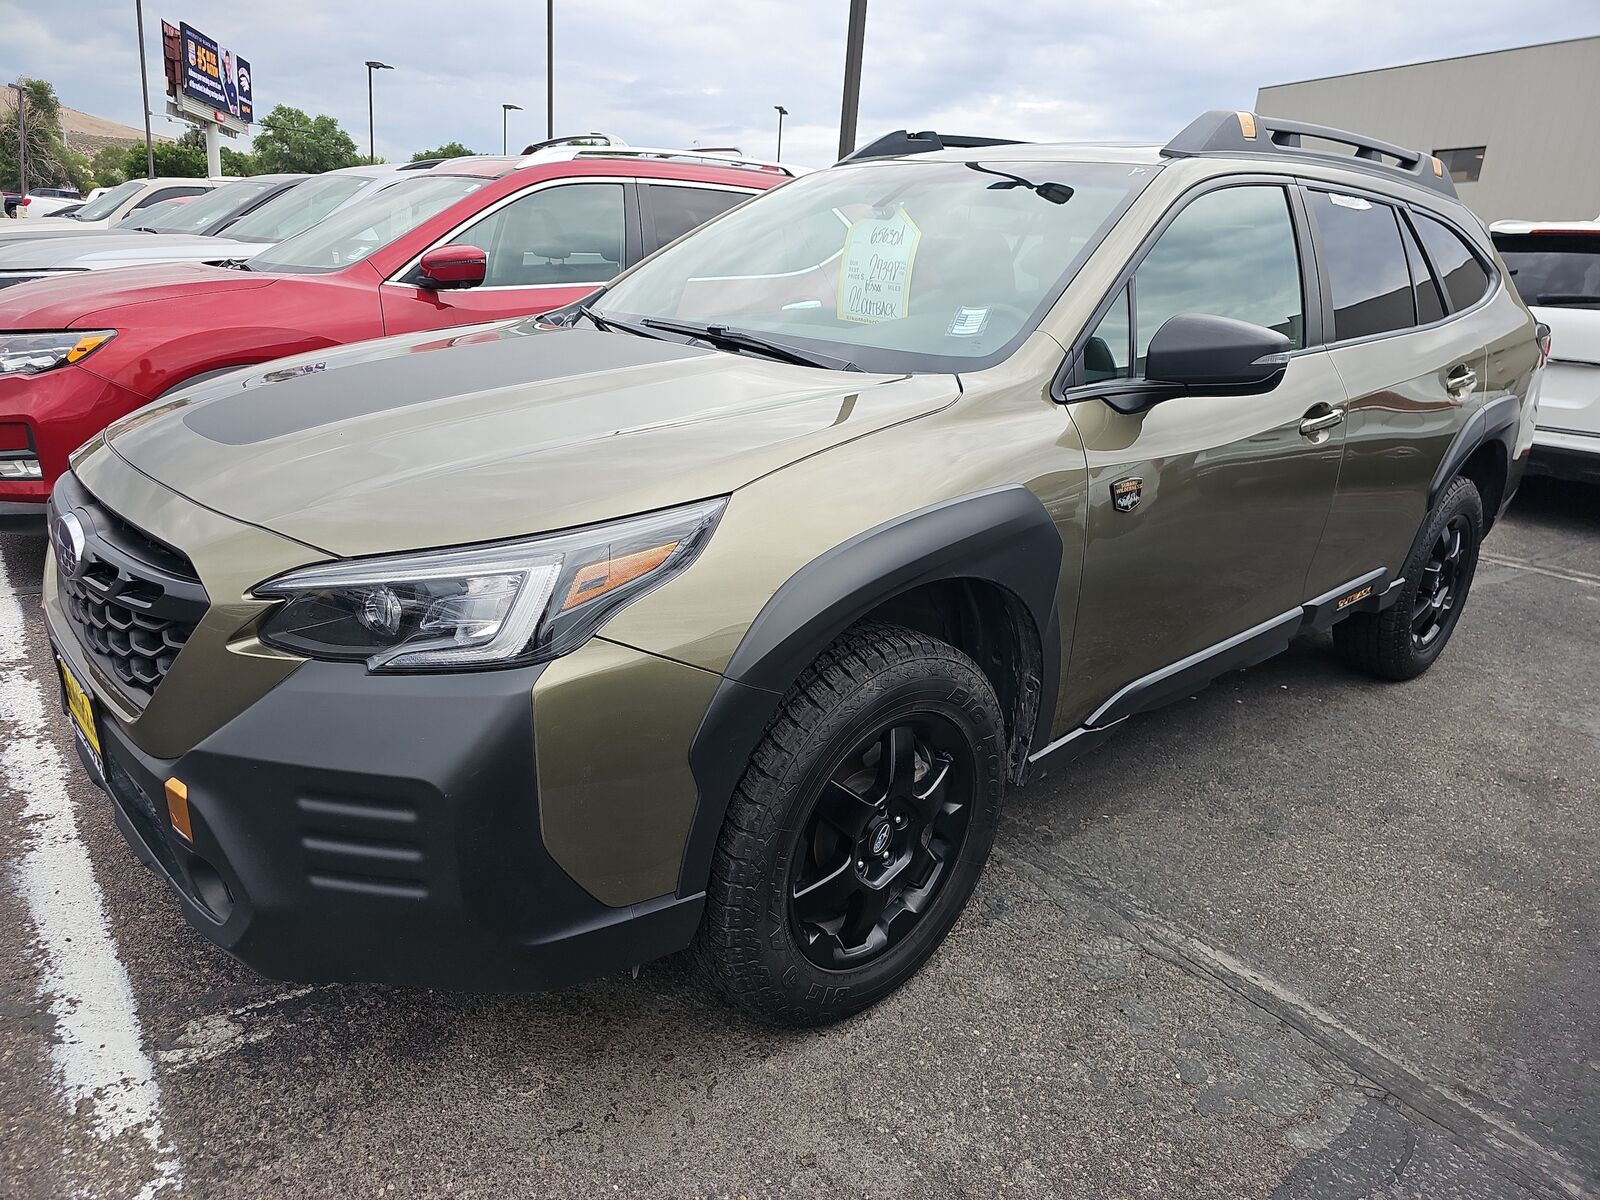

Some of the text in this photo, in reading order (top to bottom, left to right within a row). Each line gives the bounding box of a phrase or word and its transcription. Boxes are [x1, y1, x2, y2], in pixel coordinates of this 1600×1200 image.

[888, 284, 901, 292] MILES
[1116, 484, 1143, 494] WILDERNESS
[1120, 480, 1137, 488] SUBARU
[1338, 586, 1372, 607] OUTBACK
[946, 686, 987, 724] BIG
